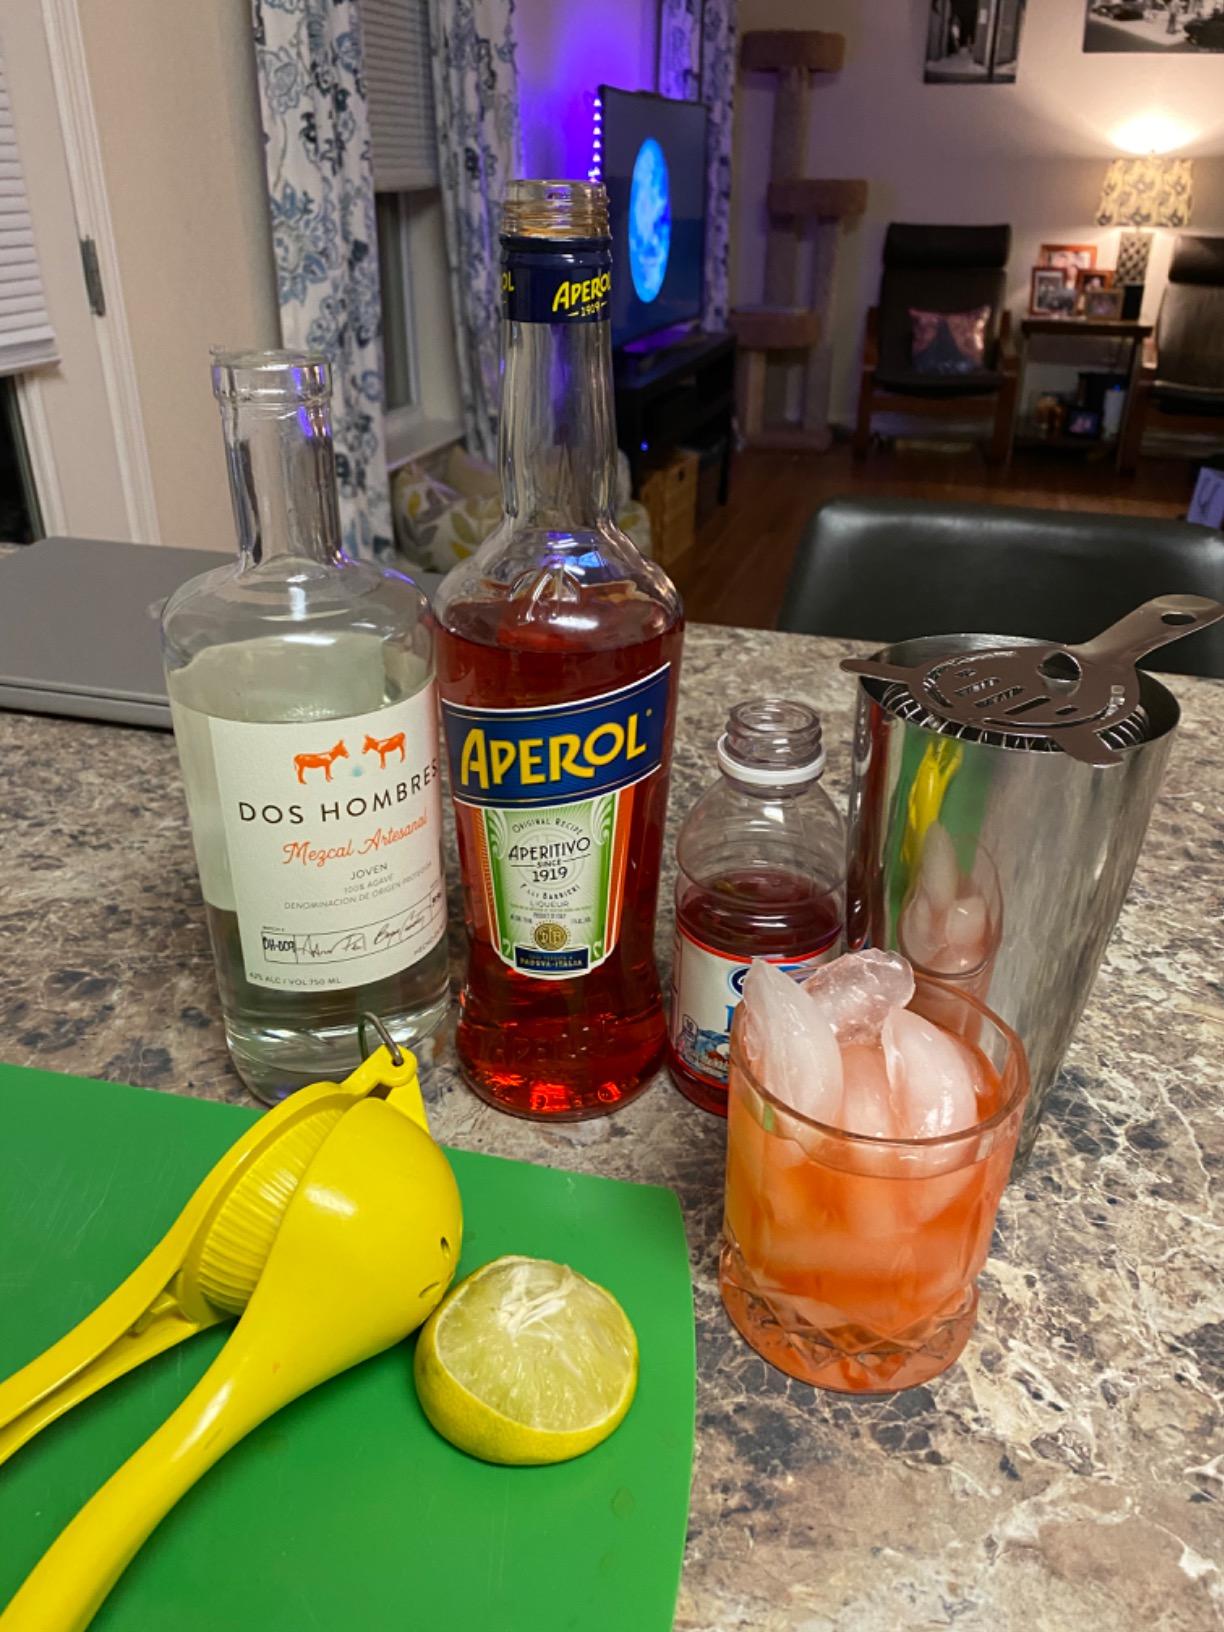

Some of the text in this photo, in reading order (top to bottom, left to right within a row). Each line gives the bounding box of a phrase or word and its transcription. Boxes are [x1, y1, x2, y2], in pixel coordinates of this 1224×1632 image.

[461, 713, 647, 790] APEROL
[239, 758, 439, 824] DOS HOMBRES
[282, 807, 428, 868] Mezcal Artesanal
[508, 837, 591, 861] APERITIVO
[351, 863, 388, 880] JOVEN
[532, 866, 567, 882] 1919
[537, 859, 561, 869] SINCE
